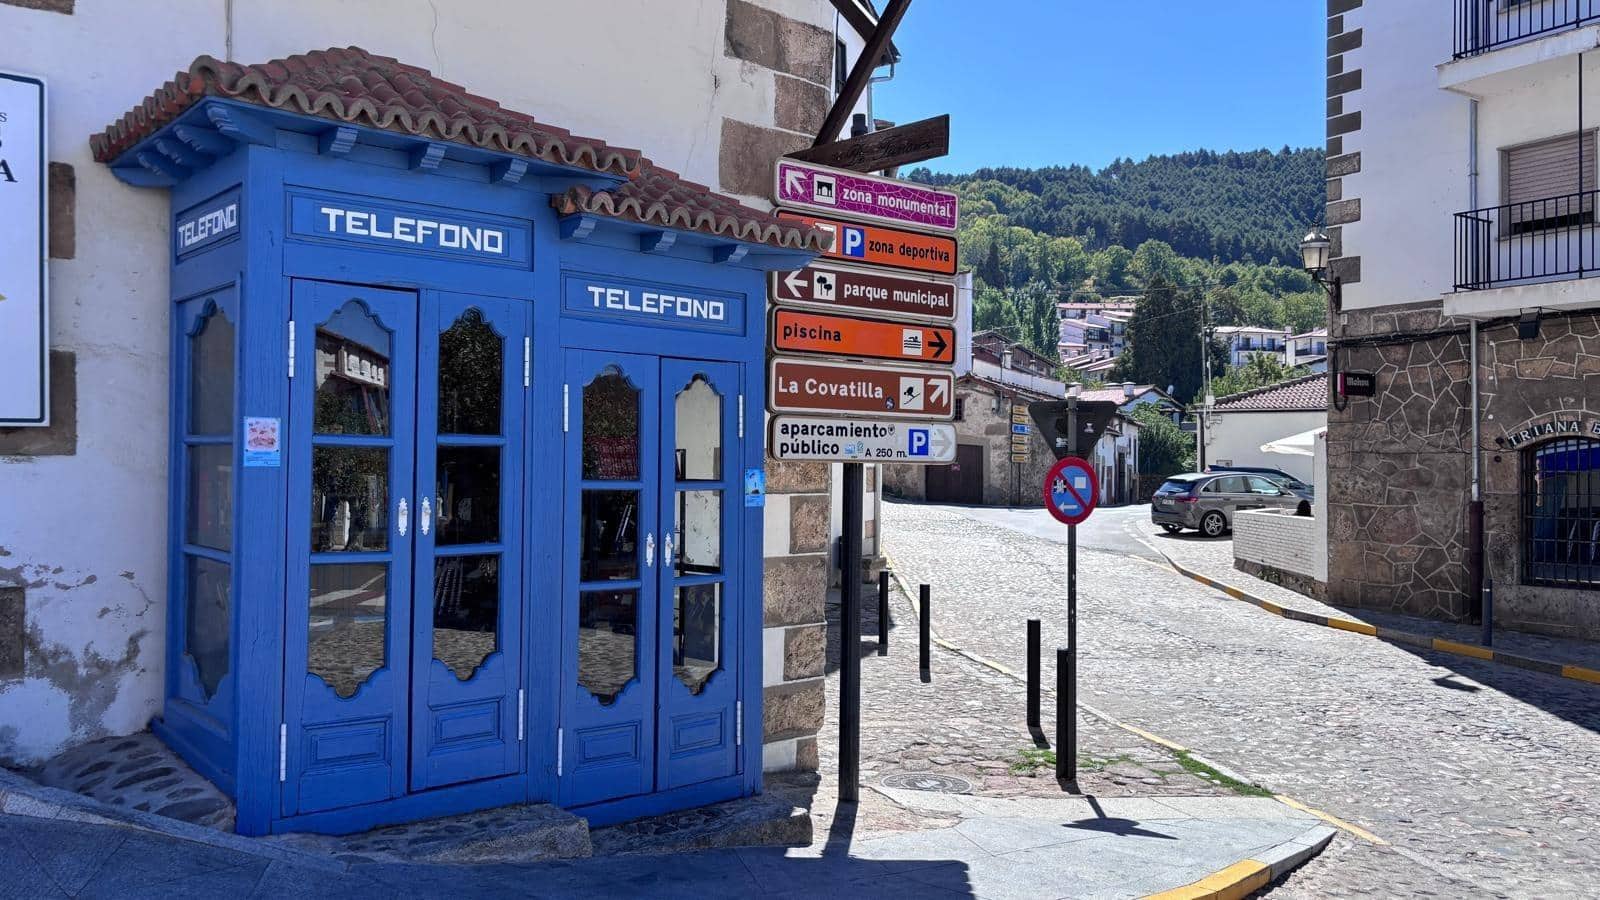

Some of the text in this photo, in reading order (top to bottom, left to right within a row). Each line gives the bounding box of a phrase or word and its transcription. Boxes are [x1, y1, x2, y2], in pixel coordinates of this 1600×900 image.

[843, 188, 951, 218] zona monumental
[178, 204, 237, 248] TELEFONO
[320, 207, 503, 254] TELEFONO
[845, 228, 950, 262] P zona deportiva
[587, 285, 724, 320] TELEFONO
[844, 283, 949, 308] parque municipal
[783, 323, 842, 342] piscina
[778, 376, 883, 399] La Covatilla
[781, 422, 888, 439] aparcamiento
[912, 431, 926, 454] P
[1509, 421, 1579, 446] TRIANA
[780, 439, 908, 458] público A 250 m.
